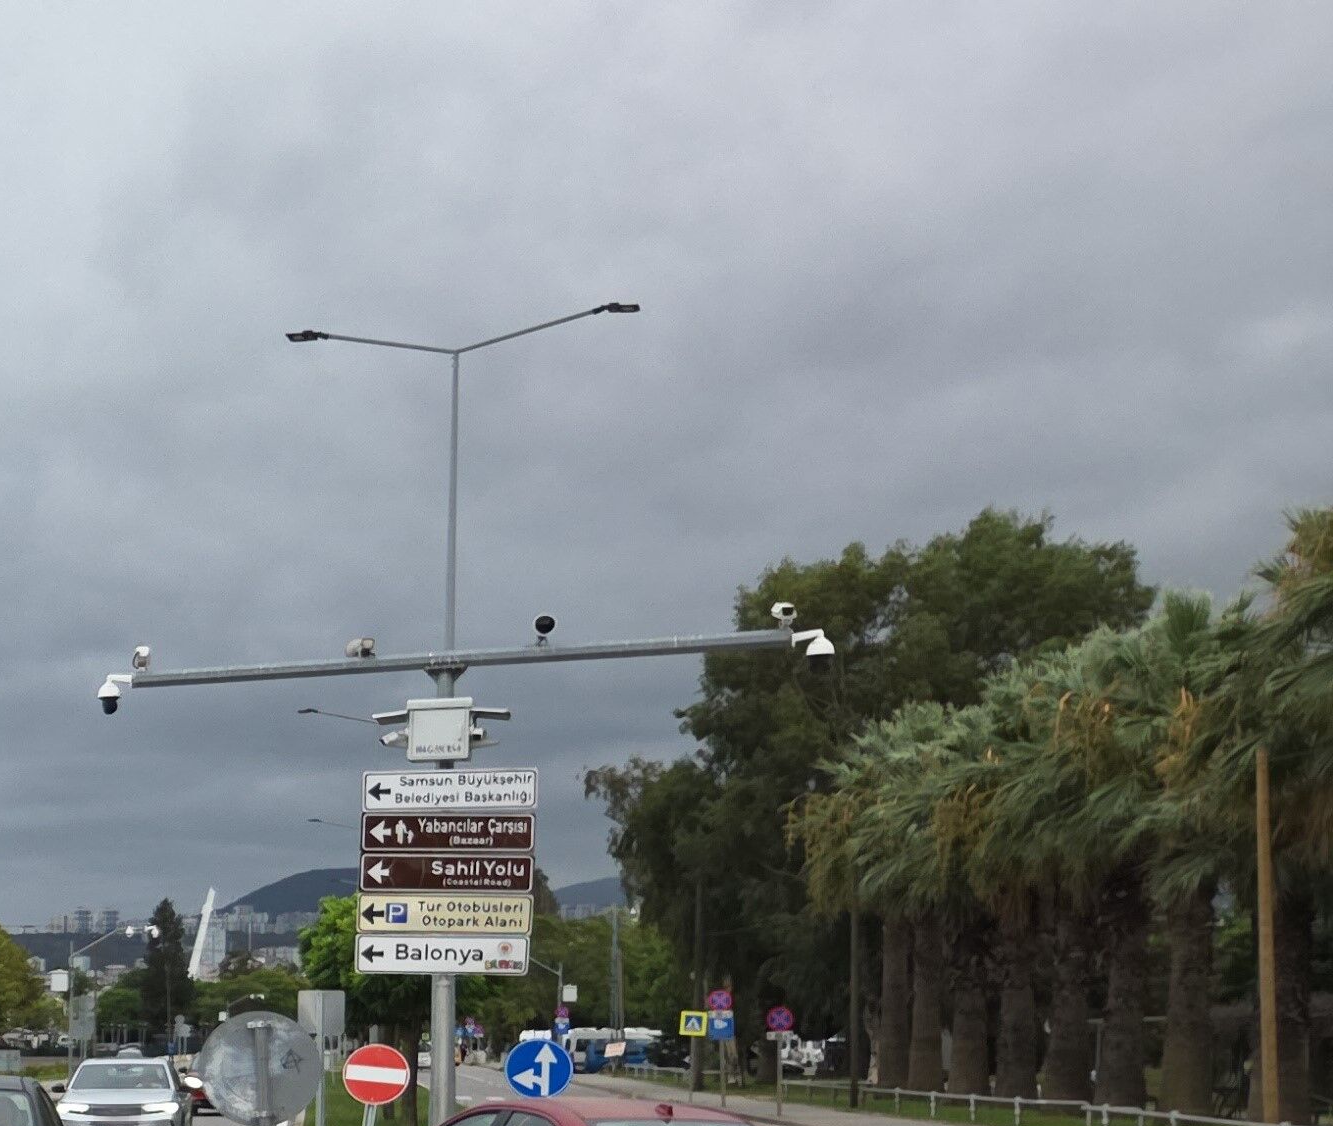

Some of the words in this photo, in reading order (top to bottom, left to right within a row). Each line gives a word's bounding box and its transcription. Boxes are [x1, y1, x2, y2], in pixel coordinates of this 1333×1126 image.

[399, 776, 453, 787] Samsun
[458, 774, 533, 787] Büyükşehir
[395, 792, 460, 805] Belediyesi
[464, 790, 532, 803] Başkanlığı
[417, 818, 484, 833] Yabancılar
[488, 818, 528, 835] Çarşısı
[431, 860, 480, 876] Sahil
[483, 861, 525, 877] Yolu
[418, 901, 442, 911] Tur
[446, 902, 523, 912] Otobüsleri
[422, 915, 479, 928] Otopark
[484, 916, 522, 927] Alanı
[395, 944, 483, 965] Balonya
